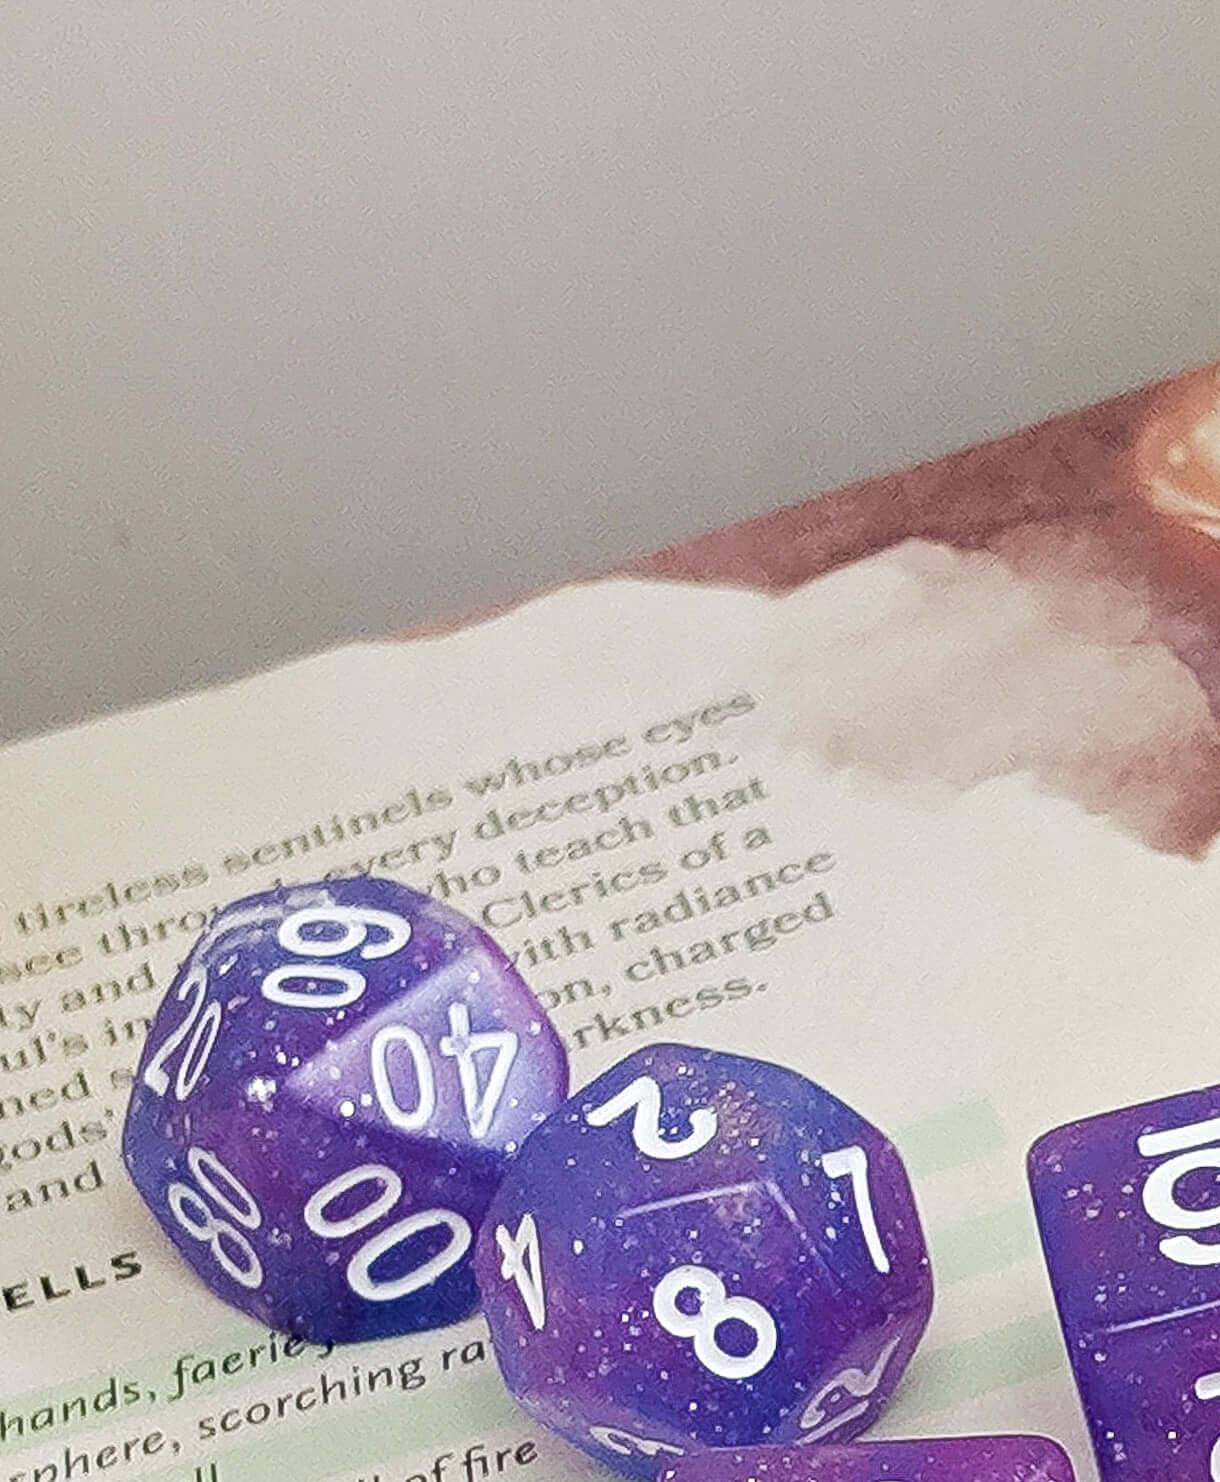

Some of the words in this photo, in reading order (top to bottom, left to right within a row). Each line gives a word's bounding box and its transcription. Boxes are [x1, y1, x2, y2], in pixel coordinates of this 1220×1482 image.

[14, 858, 208, 934] tireless
[224, 786, 453, 874] sentinels
[463, 736, 632, 796] whose
[643, 693, 756, 744] eyes
[475, 750, 738, 840] deception.
[62, 963, 155, 1012] and
[515, 816, 655, 873] teach
[668, 778, 768, 829] that
[482, 861, 667, 930] Clerics
[681, 831, 727, 869] of
[744, 825, 772, 851] a
[608, 852, 836, 941] radiance
[625, 892, 832, 982] charged
[371, 1001, 518, 1139] 40
[586, 1074, 719, 1160] 2
[7, 1160, 102, 1211] and
[168, 1147, 263, 1289] 80
[304, 1164, 472, 1301] 00
[1, 1250, 141, 1312] ELLS
[652, 1264, 778, 1379] 8
[0, 1377, 156, 1441] hands,
[198, 1359, 427, 1441] scorching
